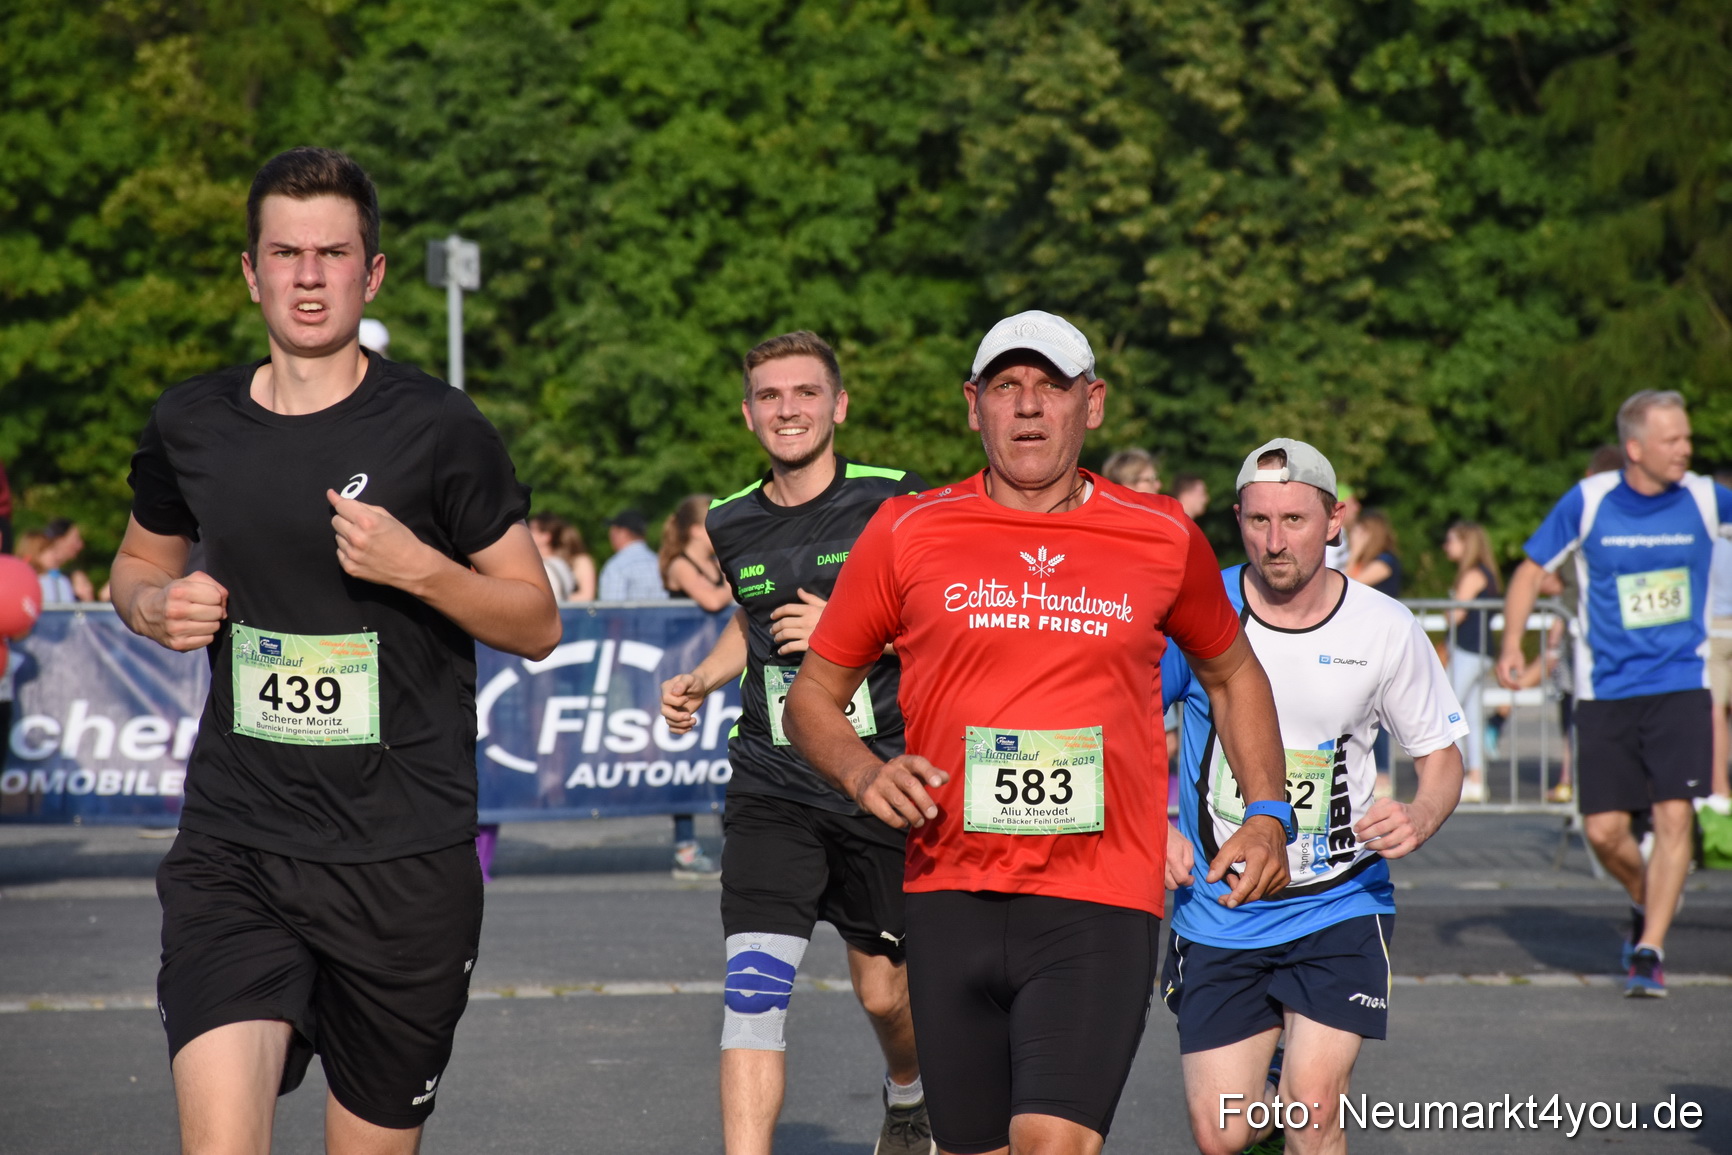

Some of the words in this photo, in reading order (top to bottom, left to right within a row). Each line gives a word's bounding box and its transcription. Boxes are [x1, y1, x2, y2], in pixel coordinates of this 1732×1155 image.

[740, 564, 765, 580] JAKO
[944, 578, 1019, 612] Echtes
[1021, 581, 1134, 623] Handwerk
[968, 612, 1030, 630] IMMER
[1038, 615, 1108, 637] FRISCH
[250, 649, 304, 667] firmenlauf
[340, 664, 368, 674] 2019
[259, 672, 342, 715] 439
[261, 711, 303, 725] Scherer
[306, 716, 342, 727] Moritz
[256, 721, 284, 733] Burnickl
[286, 723, 322, 735] Ingenieur
[324, 727, 349, 735] GmbH
[986, 748, 1041, 762] firmenlauf
[1072, 755, 1095, 766] 2019
[1305, 771, 1326, 780] 2019
[994, 768, 1073, 806] 583
[1000, 806, 1022, 817] Aliu
[1025, 806, 1069, 817] Xhevdet
[992, 816, 1005, 824] Der
[1006, 816, 1032, 825] Bäcker
[1034, 817, 1052, 825] Feihl
[1053, 816, 1076, 824] GmbH
